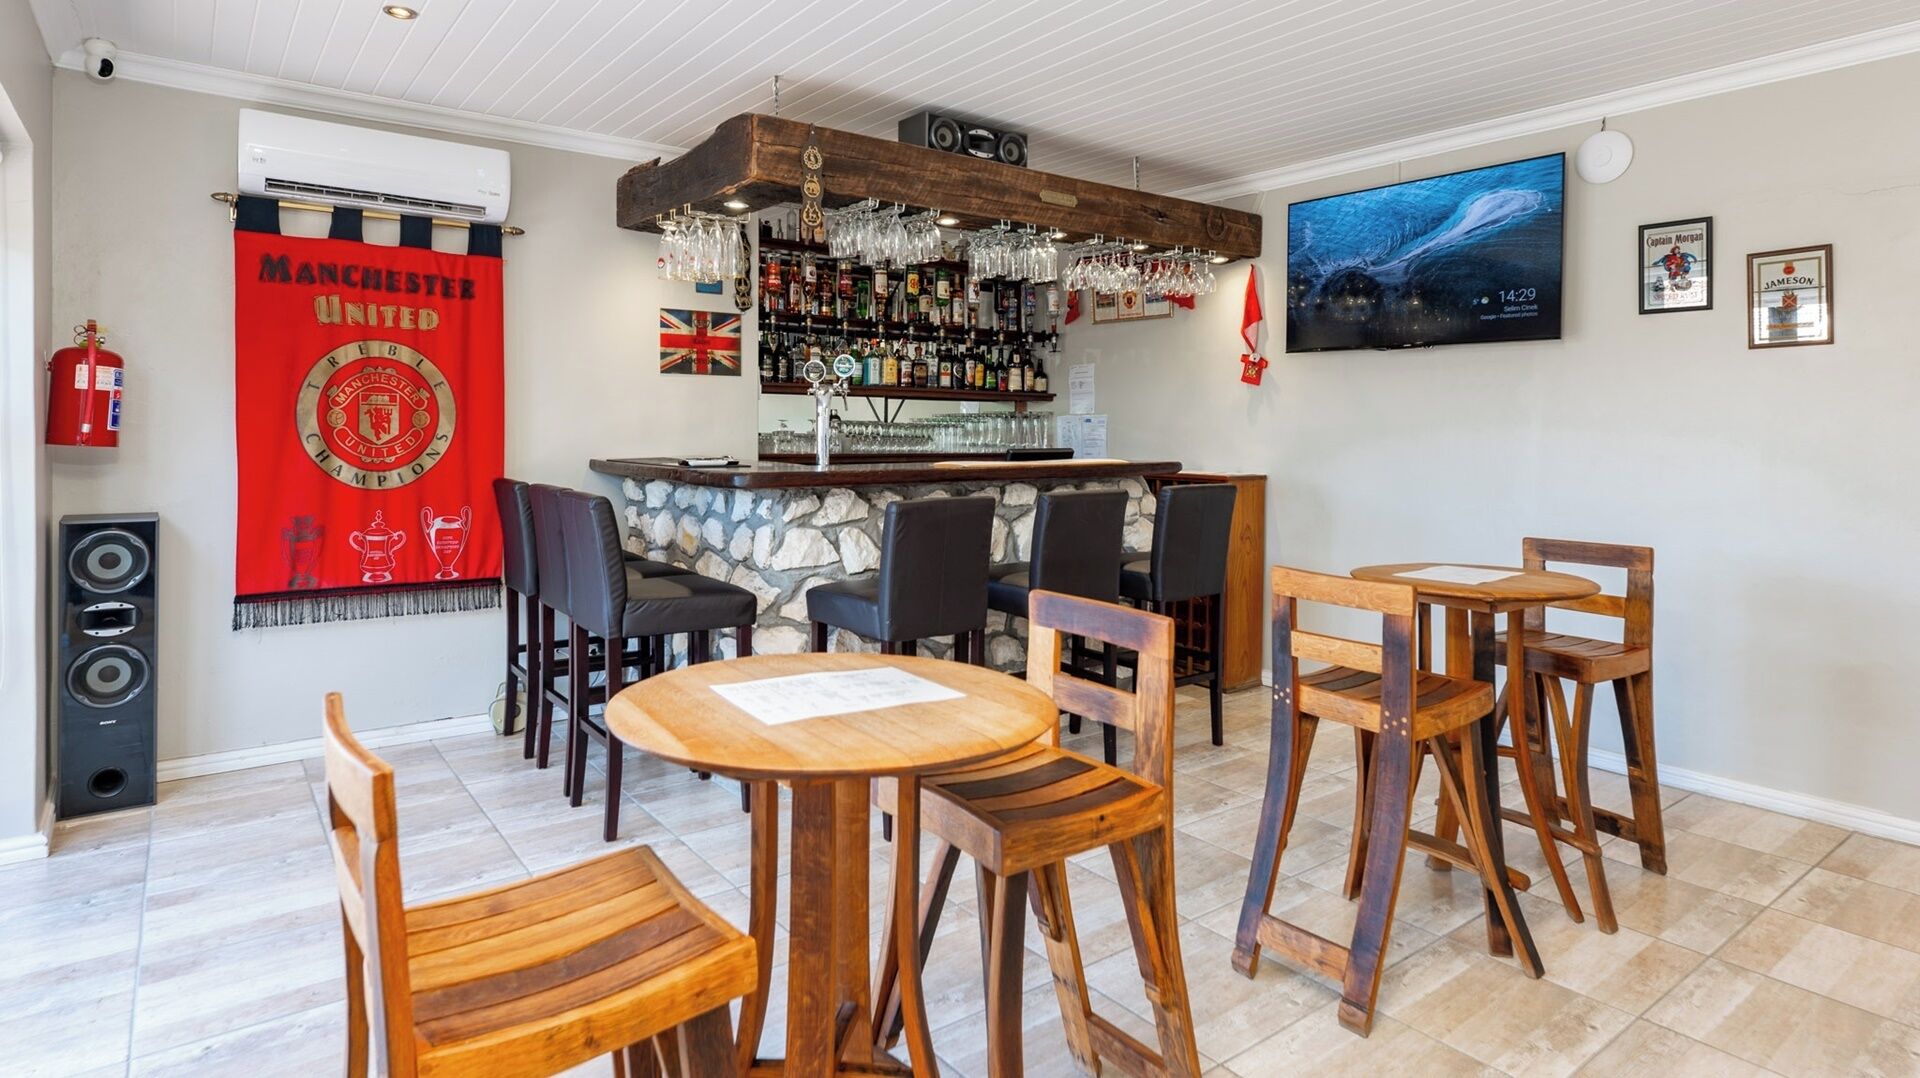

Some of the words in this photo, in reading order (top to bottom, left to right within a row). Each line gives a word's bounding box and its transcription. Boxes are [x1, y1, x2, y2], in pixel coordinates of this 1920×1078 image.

[1646, 235, 1673, 248] Captain
[1674, 232, 1704, 246] Morgan
[258, 253, 476, 300] MANCHESTER
[1764, 276, 1814, 290] JAMESON
[1499, 287, 1537, 303] 14:29
[314, 294, 440, 331] UNITED
[306, 343, 445, 392] TREBLE
[335, 373, 420, 404] MANCHESTER
[305, 432, 449, 488] CHAMPIONS
[345, 436, 415, 457] UNITED
